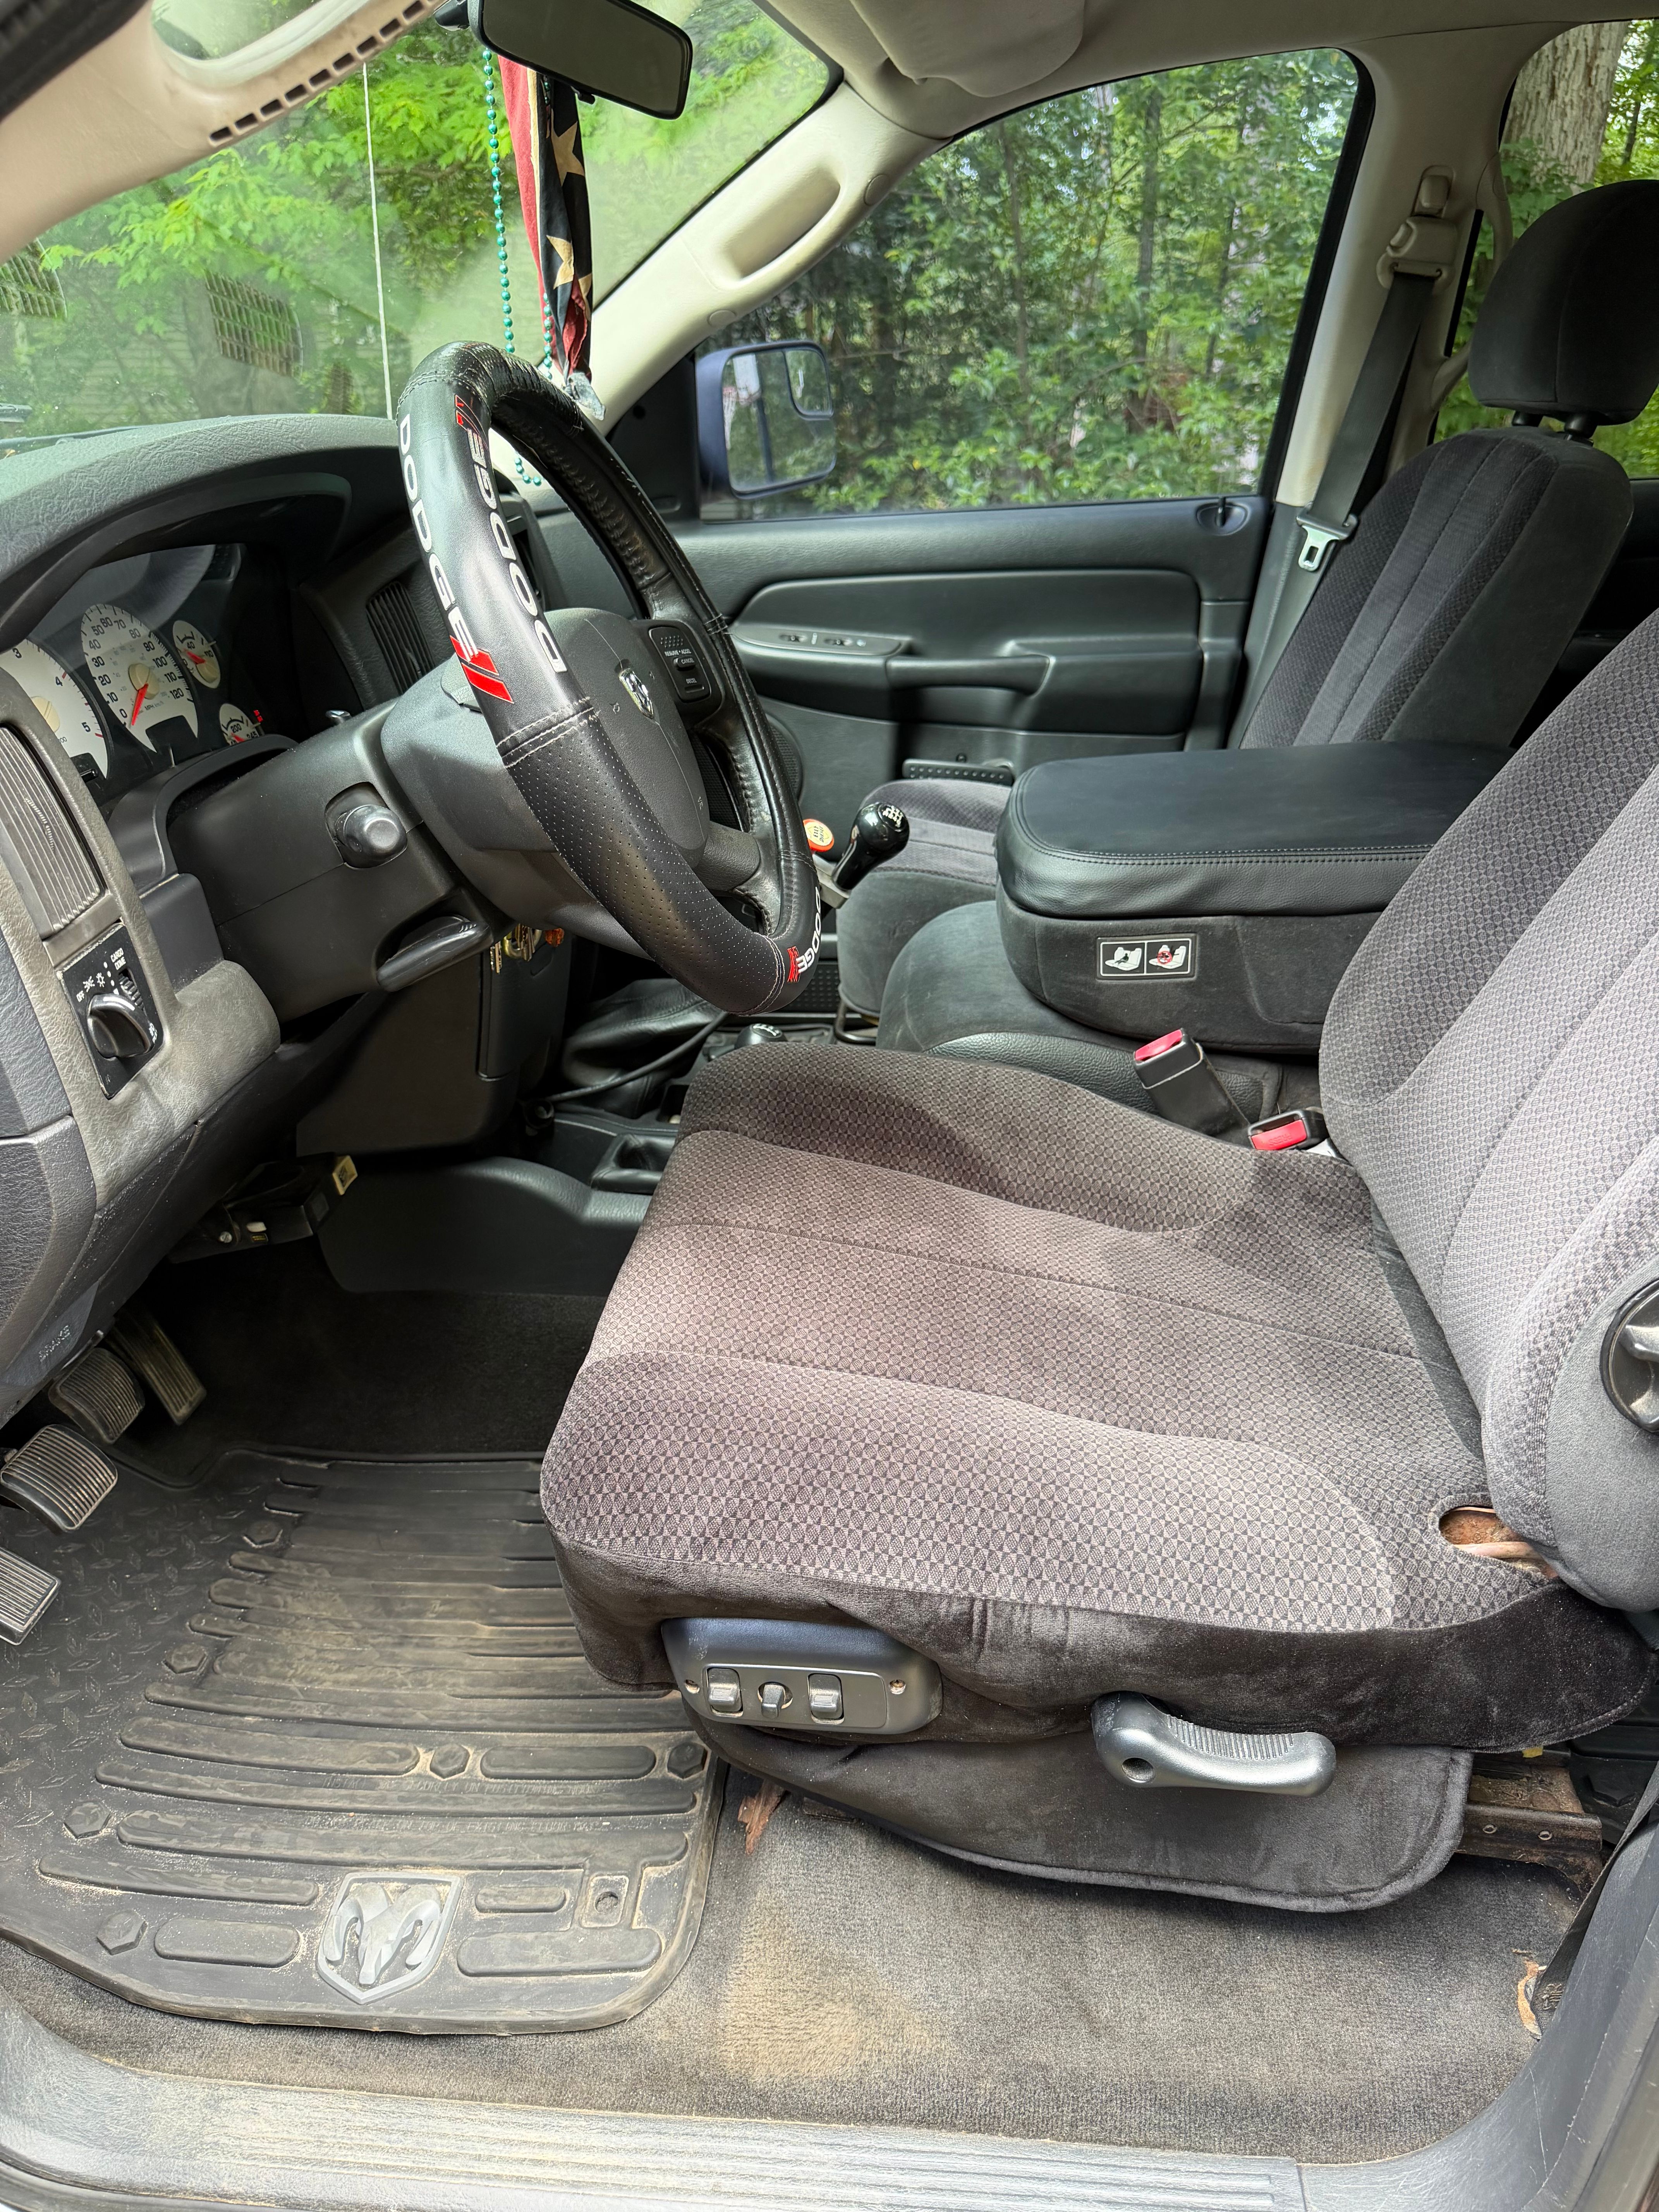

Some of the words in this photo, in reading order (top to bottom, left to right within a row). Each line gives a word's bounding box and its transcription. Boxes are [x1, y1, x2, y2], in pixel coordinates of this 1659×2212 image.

[400, 413, 478, 662] DODGE
[467, 428, 567, 673] DODGE
[100, 617, 113, 627] 60
[114, 619, 126, 630] 70
[91, 625, 105, 635] 50
[129, 628, 141, 639] 80
[89, 639, 101, 650] 40
[143, 641, 155, 651] 90
[12, 648, 22, 658] 3
[91, 656, 105, 667] 30
[153, 656, 168, 668] 100
[55, 677, 63, 686] 4
[98, 674, 111, 686] 20
[164, 672, 177, 682] 110
[106, 692, 118, 702] 10
[170, 688, 184, 699] 120
[119, 709, 127, 718] 0
[81, 722, 91, 732] 5
[231, 723, 242, 733] 200
[110, 948, 124, 962] CARGO
[114, 957, 126, 970] DOME
[76, 990, 84, 1002] OFF
